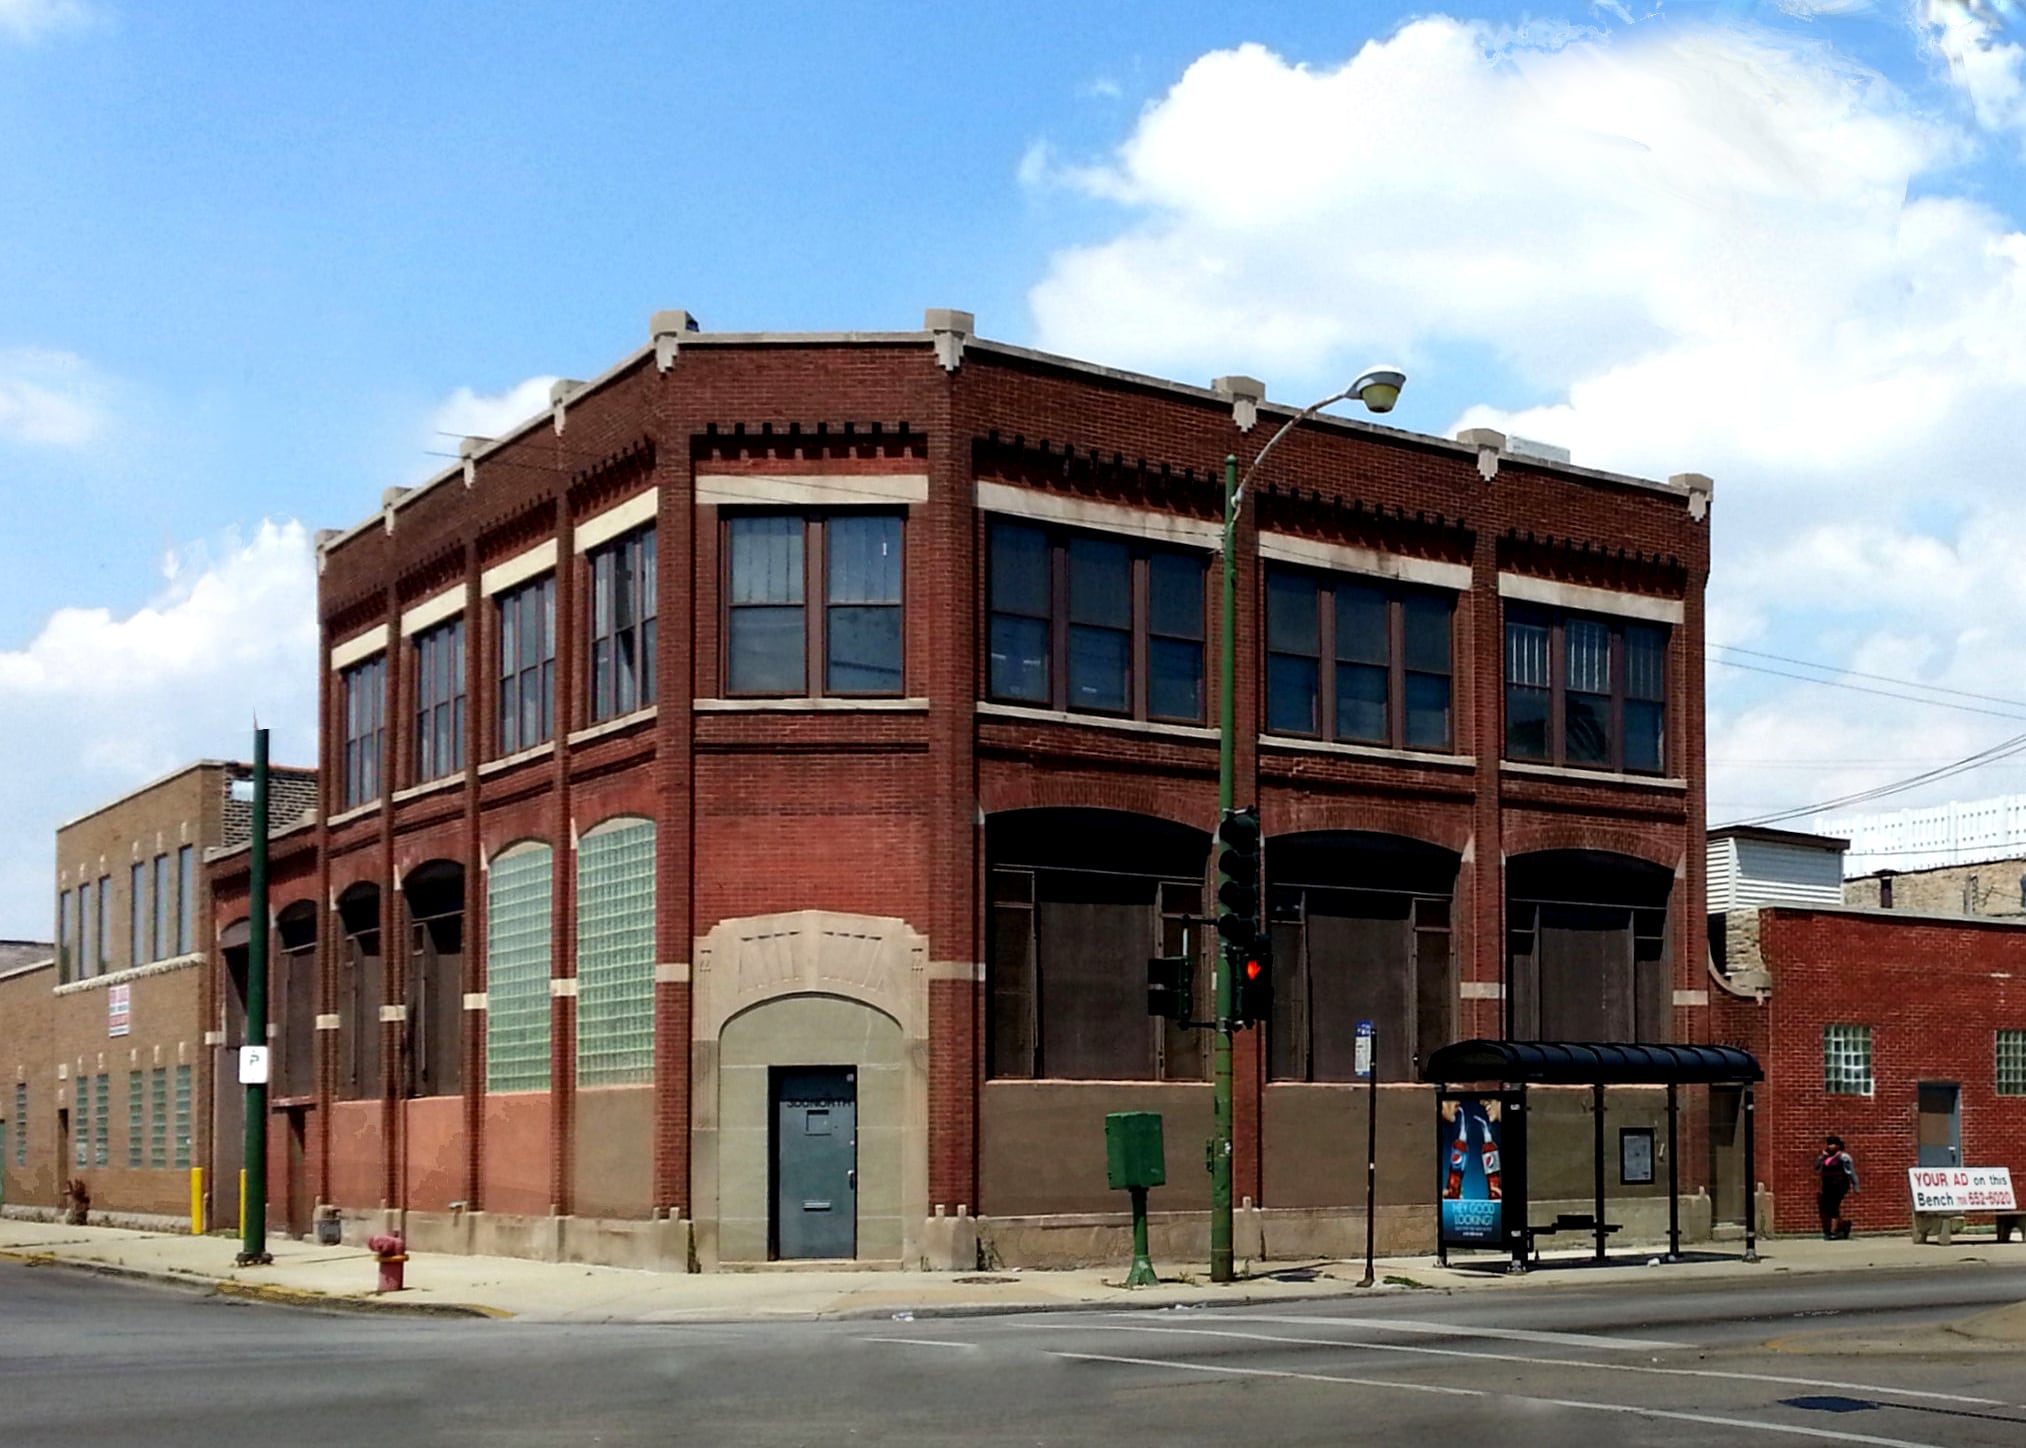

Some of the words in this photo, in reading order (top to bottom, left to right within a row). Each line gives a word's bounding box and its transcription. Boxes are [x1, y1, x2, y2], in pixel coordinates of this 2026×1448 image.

[1914, 1172, 1948, 1187] YOUR
[1954, 1172, 1969, 1186] AD
[1973, 1176, 1985, 1186] on
[1989, 1174, 2008, 1186] this
[1917, 1192, 1954, 1207] Bench
[1452, 1202, 1468, 1213] HEY
[1469, 1202, 1496, 1214] GOOD
